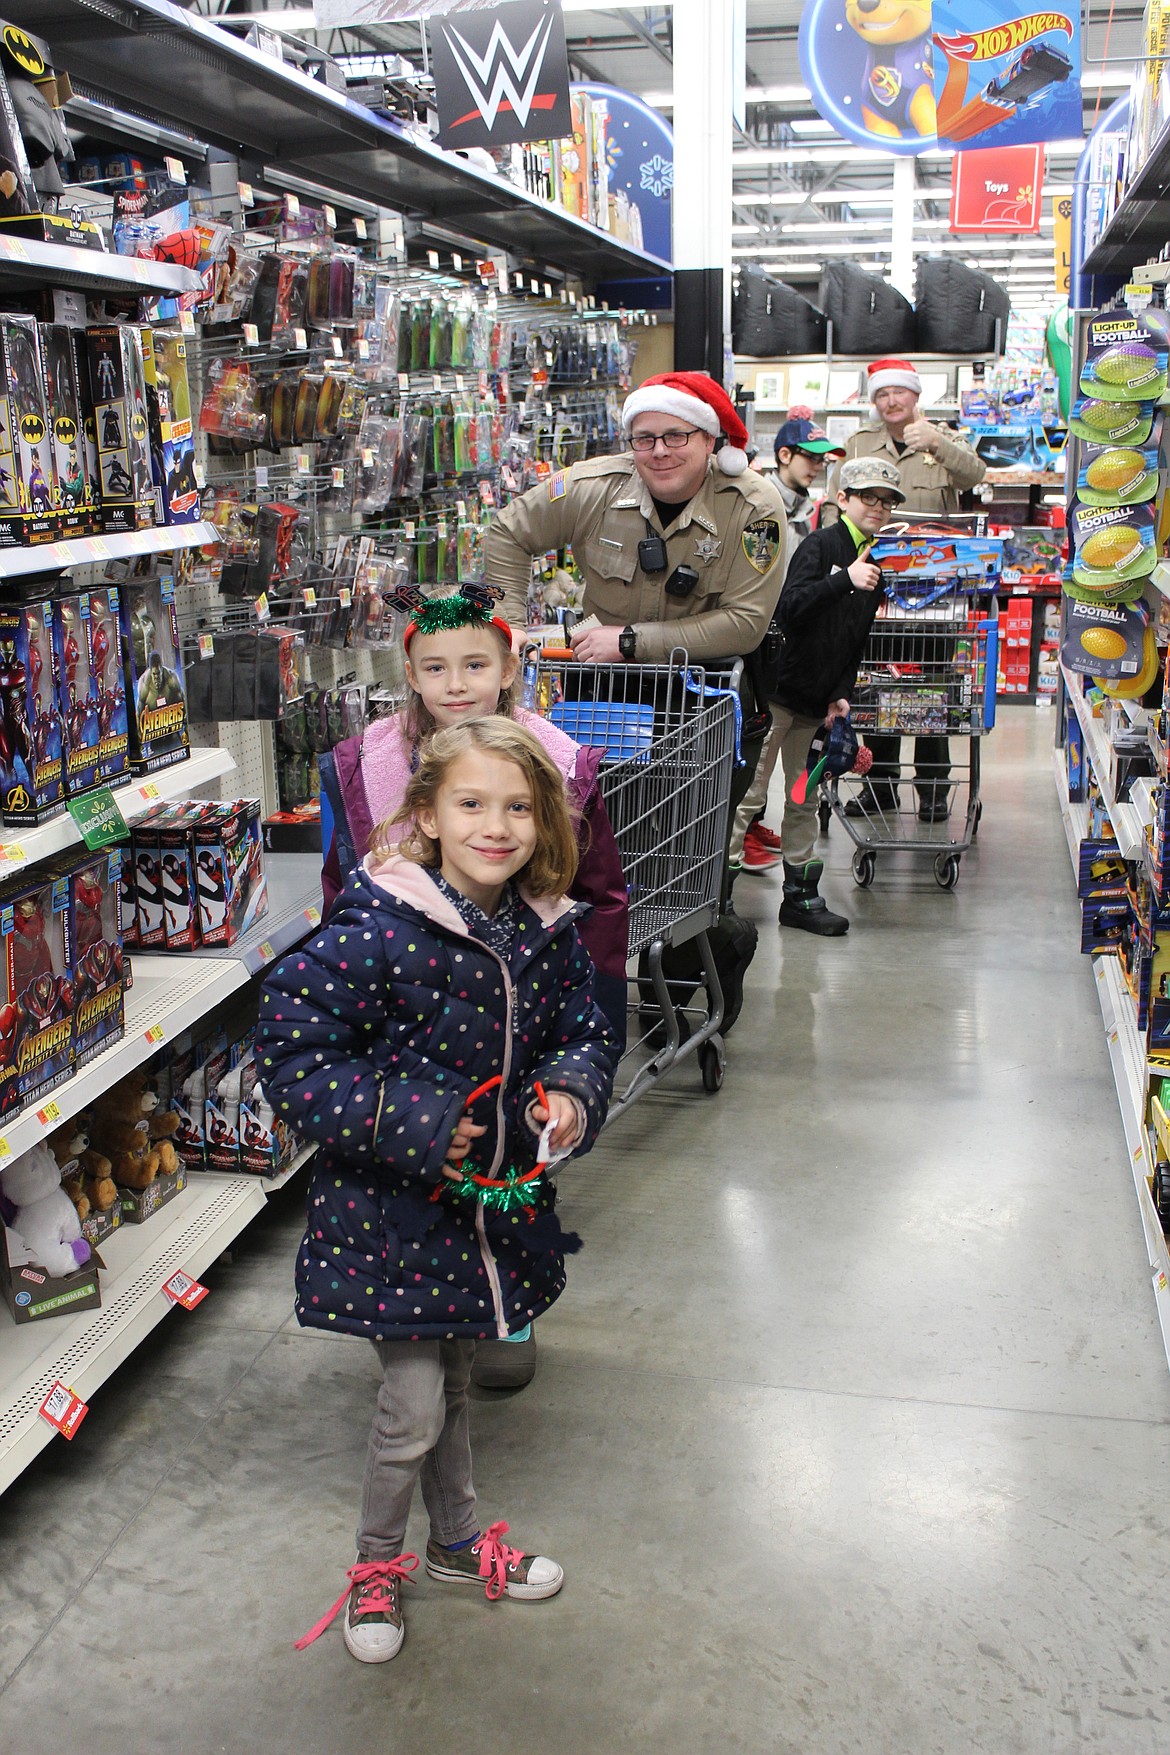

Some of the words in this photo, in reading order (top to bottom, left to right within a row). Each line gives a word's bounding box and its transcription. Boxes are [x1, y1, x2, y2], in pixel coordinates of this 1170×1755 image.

[970, 29, 1011, 60] HOT
[1005, 14, 1067, 50] WHEELS
[985, 180, 1009, 196] Toys
[1093, 329, 1151, 343] FOOTBALL
[1094, 322, 1135, 332] LIGHT-UP
[1078, 507, 1135, 531] FOOTBALL
[1003, 571, 1020, 580] KID
[1073, 604, 1127, 622] FOOTBALL
[1040, 676, 1057, 686] KID
[140, 702, 185, 742] AVENGERS
[147, 760, 160, 771] TITAN
[160, 754, 171, 766] HERO
[171, 748, 187, 760] SERIES
[79, 804, 121, 835] EXCLUSIVE
[76, 980, 122, 1037] AVENGERS
[105, 1028, 121, 1045] SERIES
[18, 1015, 73, 1077] AVENGERS
[55, 1039, 71, 1053] WAR
[23, 1087, 40, 1106] TITAN
[40, 1078, 55, 1094] HERO
[55, 1065, 73, 1084] SERIES
[209, 1154, 237, 1164] SPIDER-MAN
[242, 1154, 271, 1166] SPIDER-MAN
[39, 1299, 57, 1312] LIVE
[57, 1291, 87, 1307] ANIMAL
[187, 1286, 204, 1302] Rollback
[68, 1402, 84, 1428] Rollback
